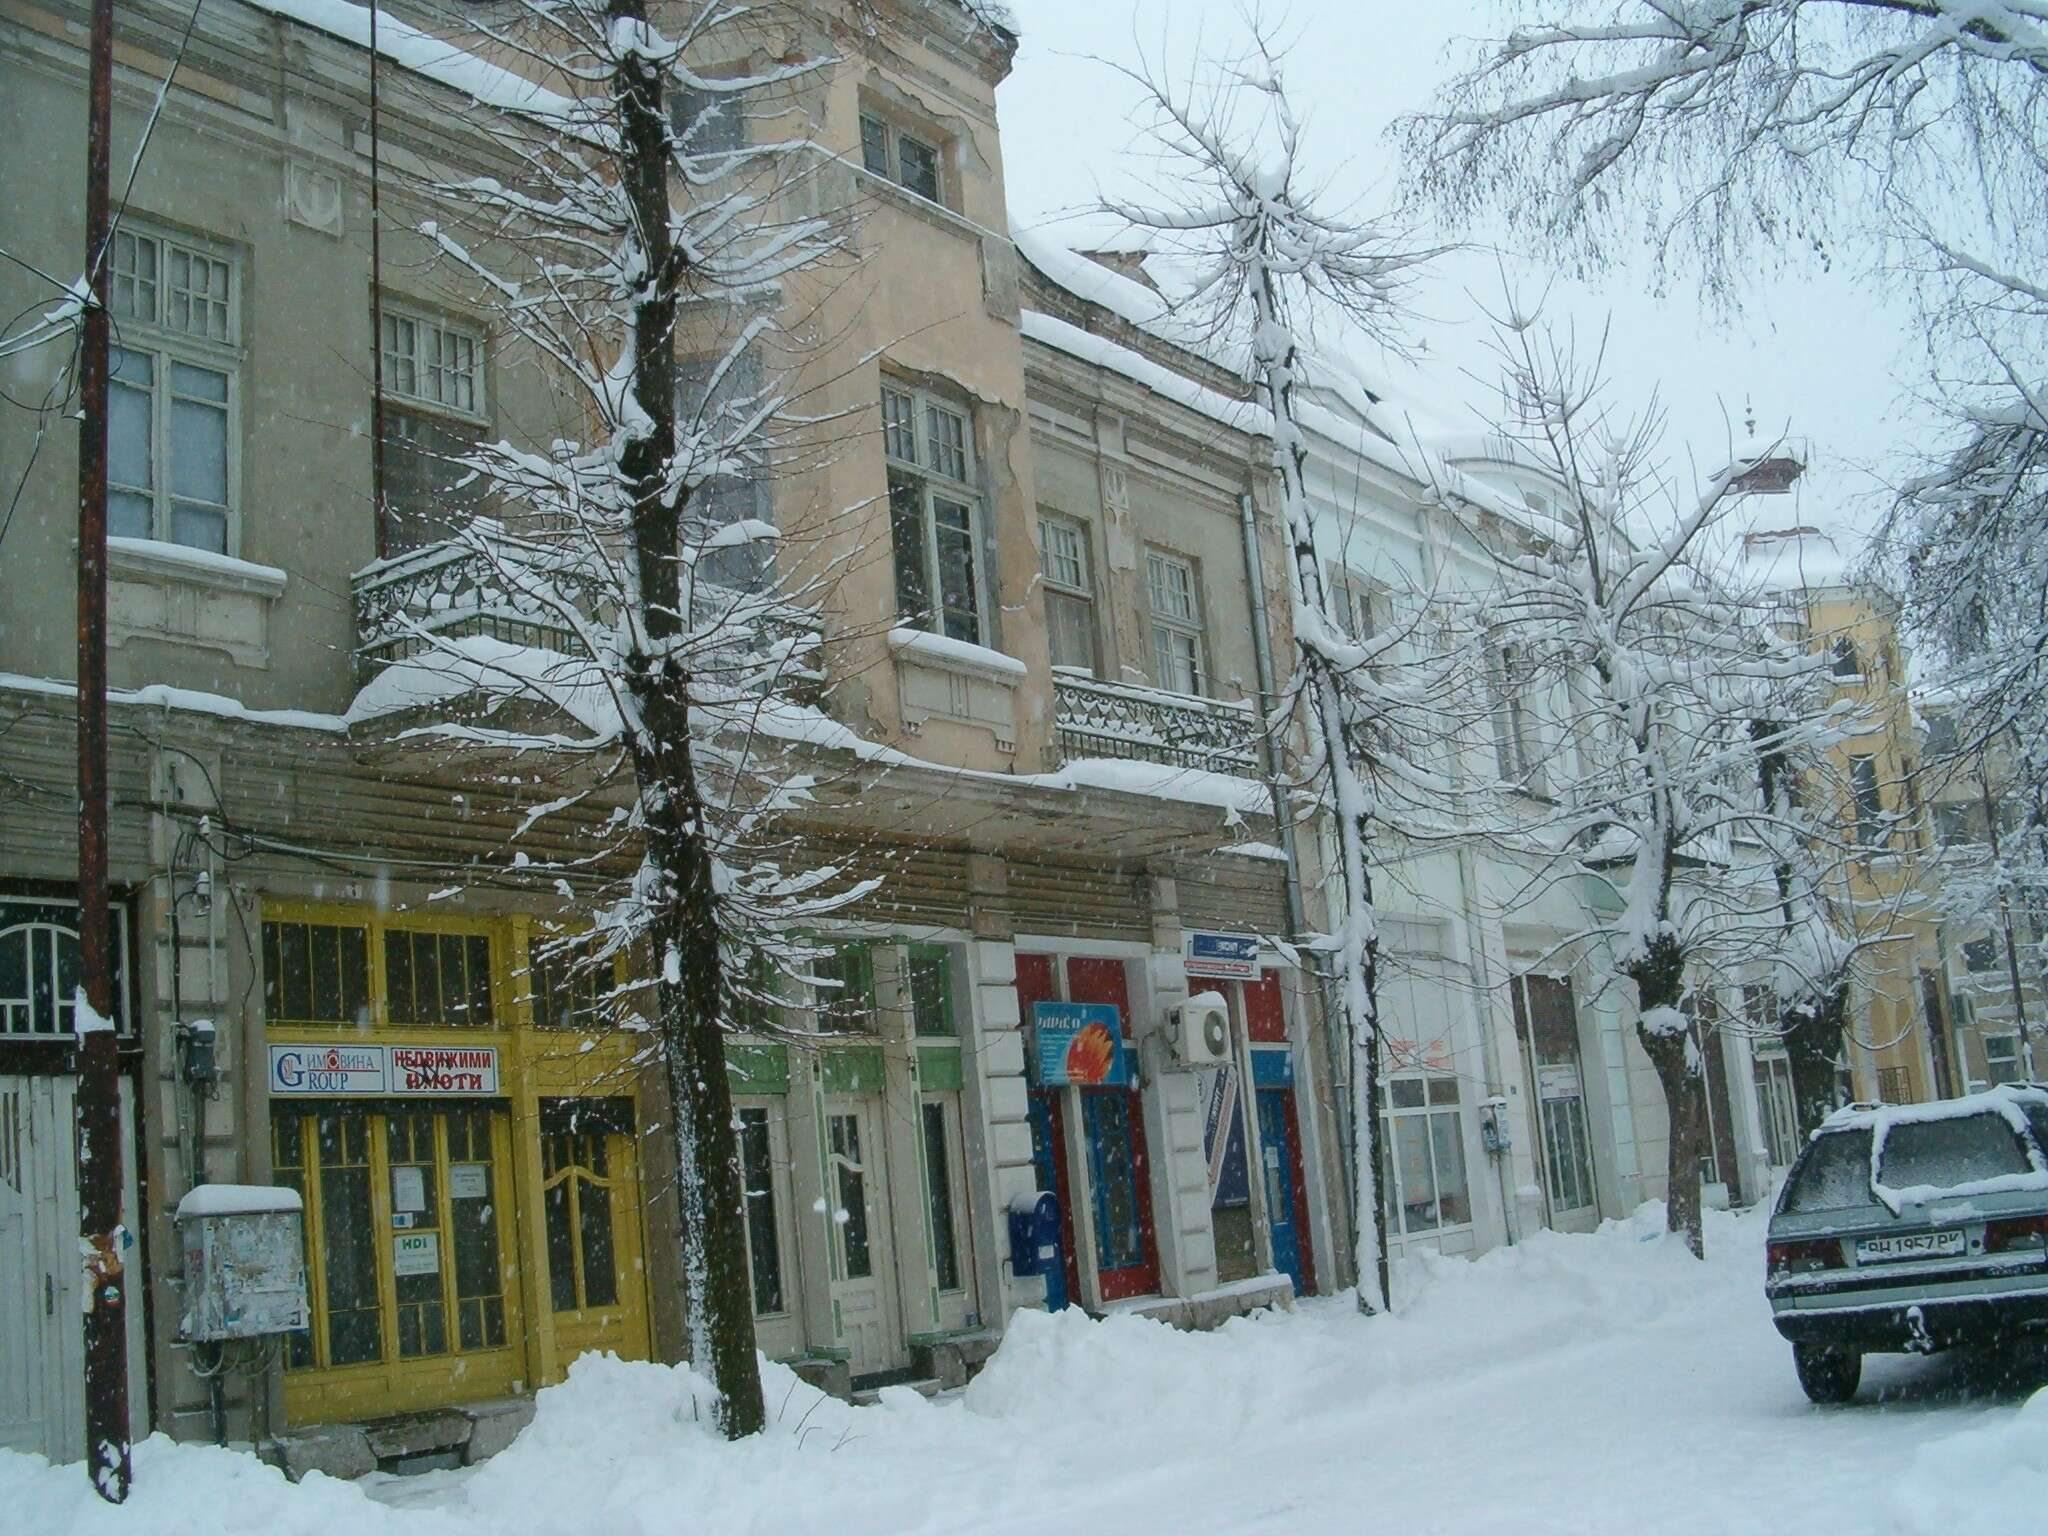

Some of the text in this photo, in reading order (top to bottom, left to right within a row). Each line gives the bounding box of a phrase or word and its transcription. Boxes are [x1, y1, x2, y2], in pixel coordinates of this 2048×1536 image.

[307, 1052, 375, 1069] ИМОВИНА
[394, 1050, 491, 1068] НЕДВИЖИМИ
[406, 1073, 482, 1090] ИМОТИ
[1895, 1235, 1935, 1252] 1957
